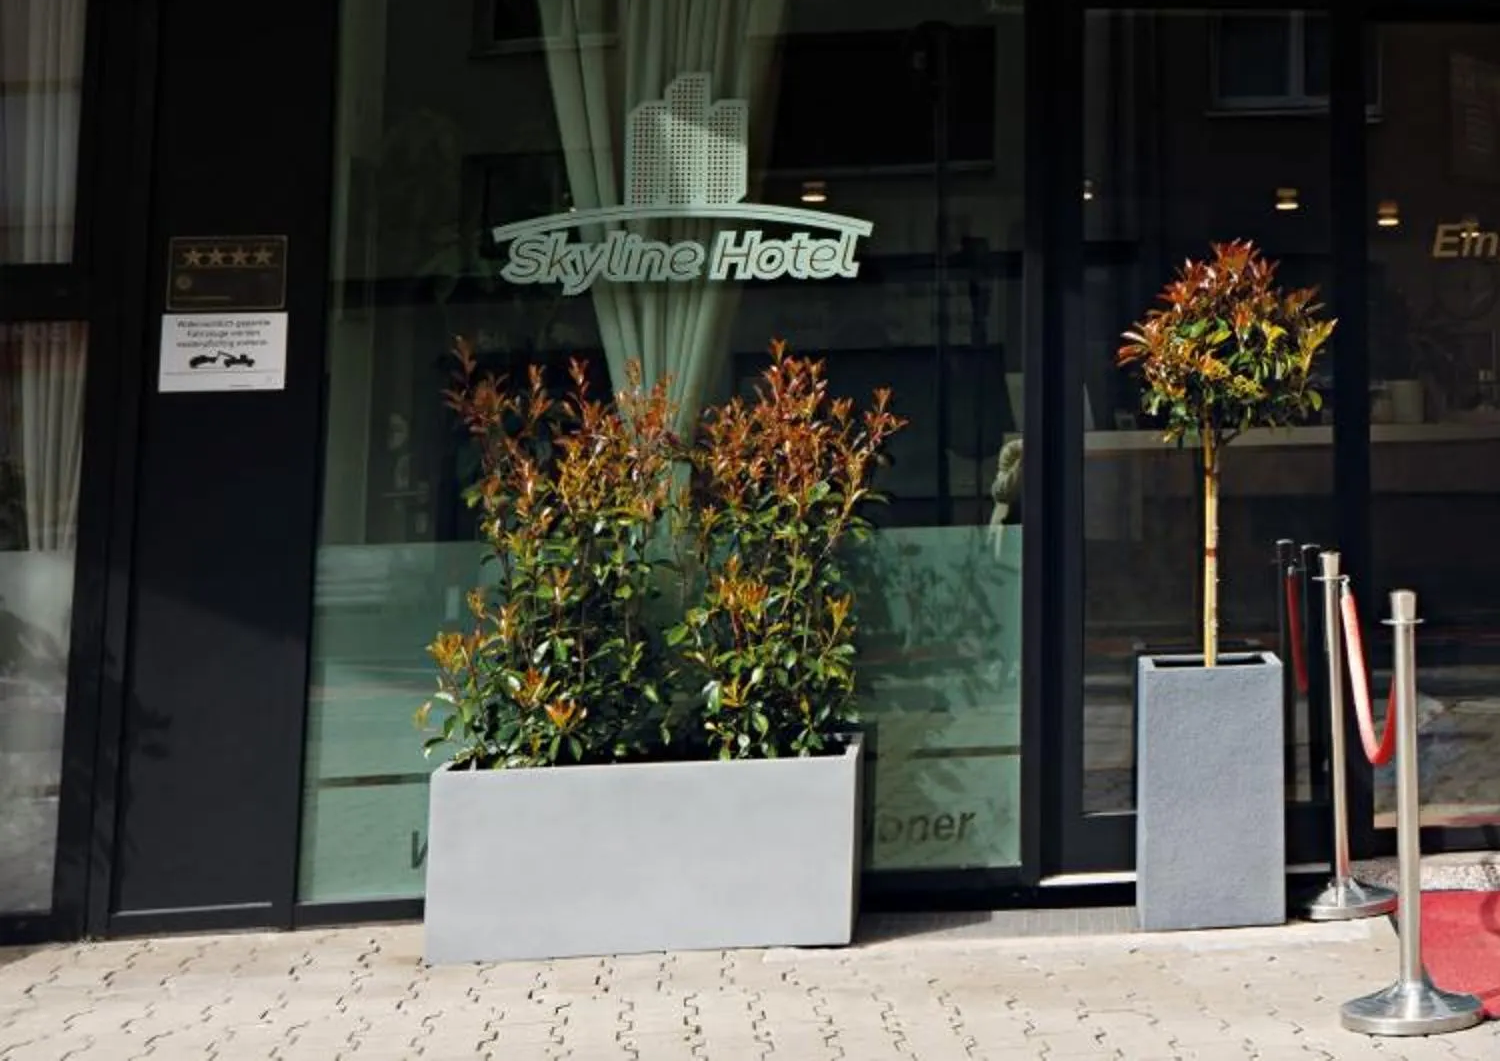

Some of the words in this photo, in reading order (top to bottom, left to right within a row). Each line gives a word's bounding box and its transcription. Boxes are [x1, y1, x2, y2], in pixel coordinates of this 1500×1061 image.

[500, 229, 706, 296] Skyline
[708, 229, 860, 280] Hotel
[877, 811, 977, 844] oner
